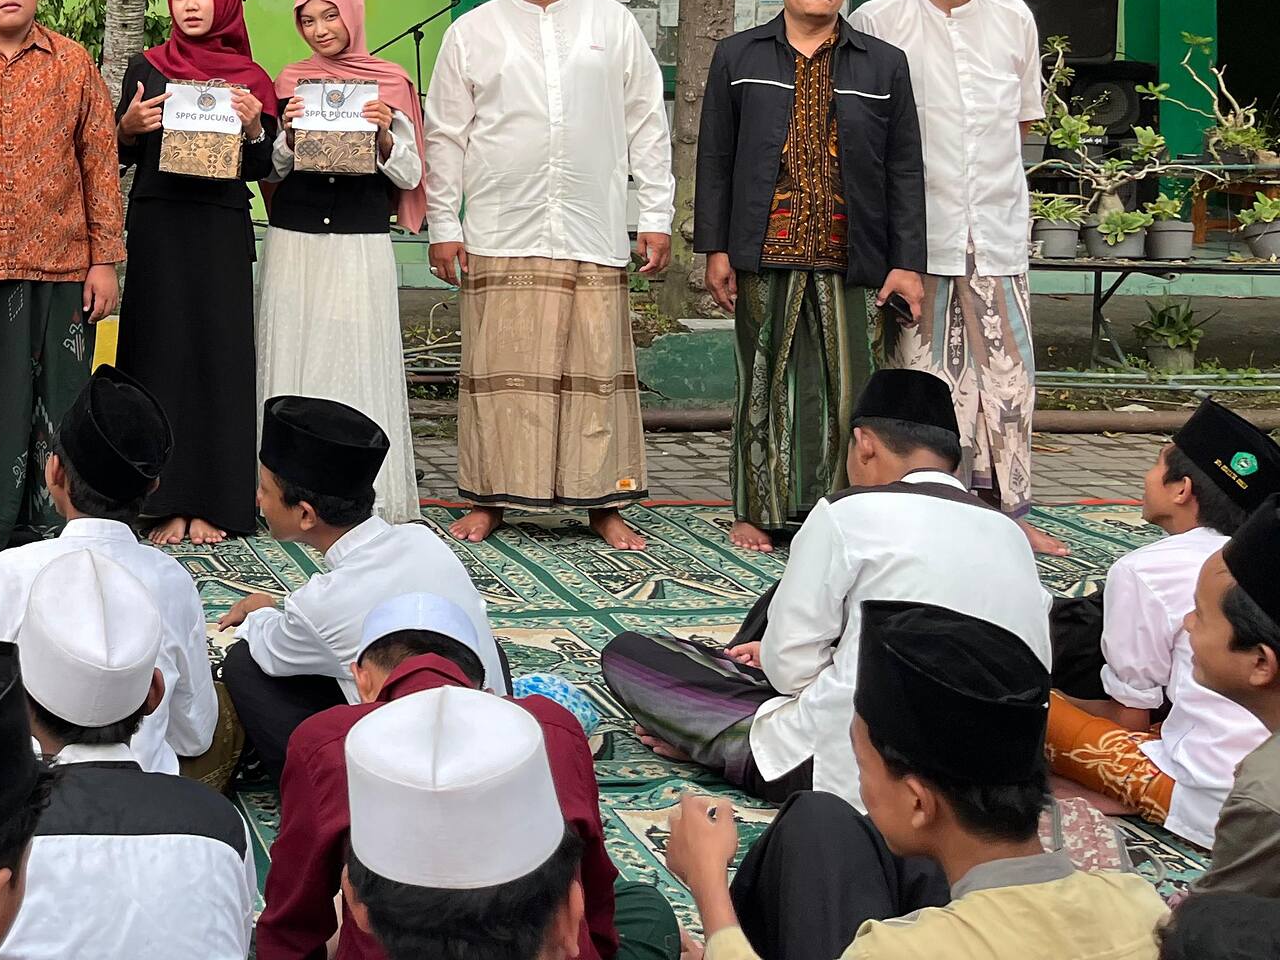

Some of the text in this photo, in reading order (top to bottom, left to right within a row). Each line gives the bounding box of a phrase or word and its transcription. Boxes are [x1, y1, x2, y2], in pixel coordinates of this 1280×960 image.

[175, 111, 235, 123] SPPG PUCUNG
[304, 110, 326, 118] SPPG
